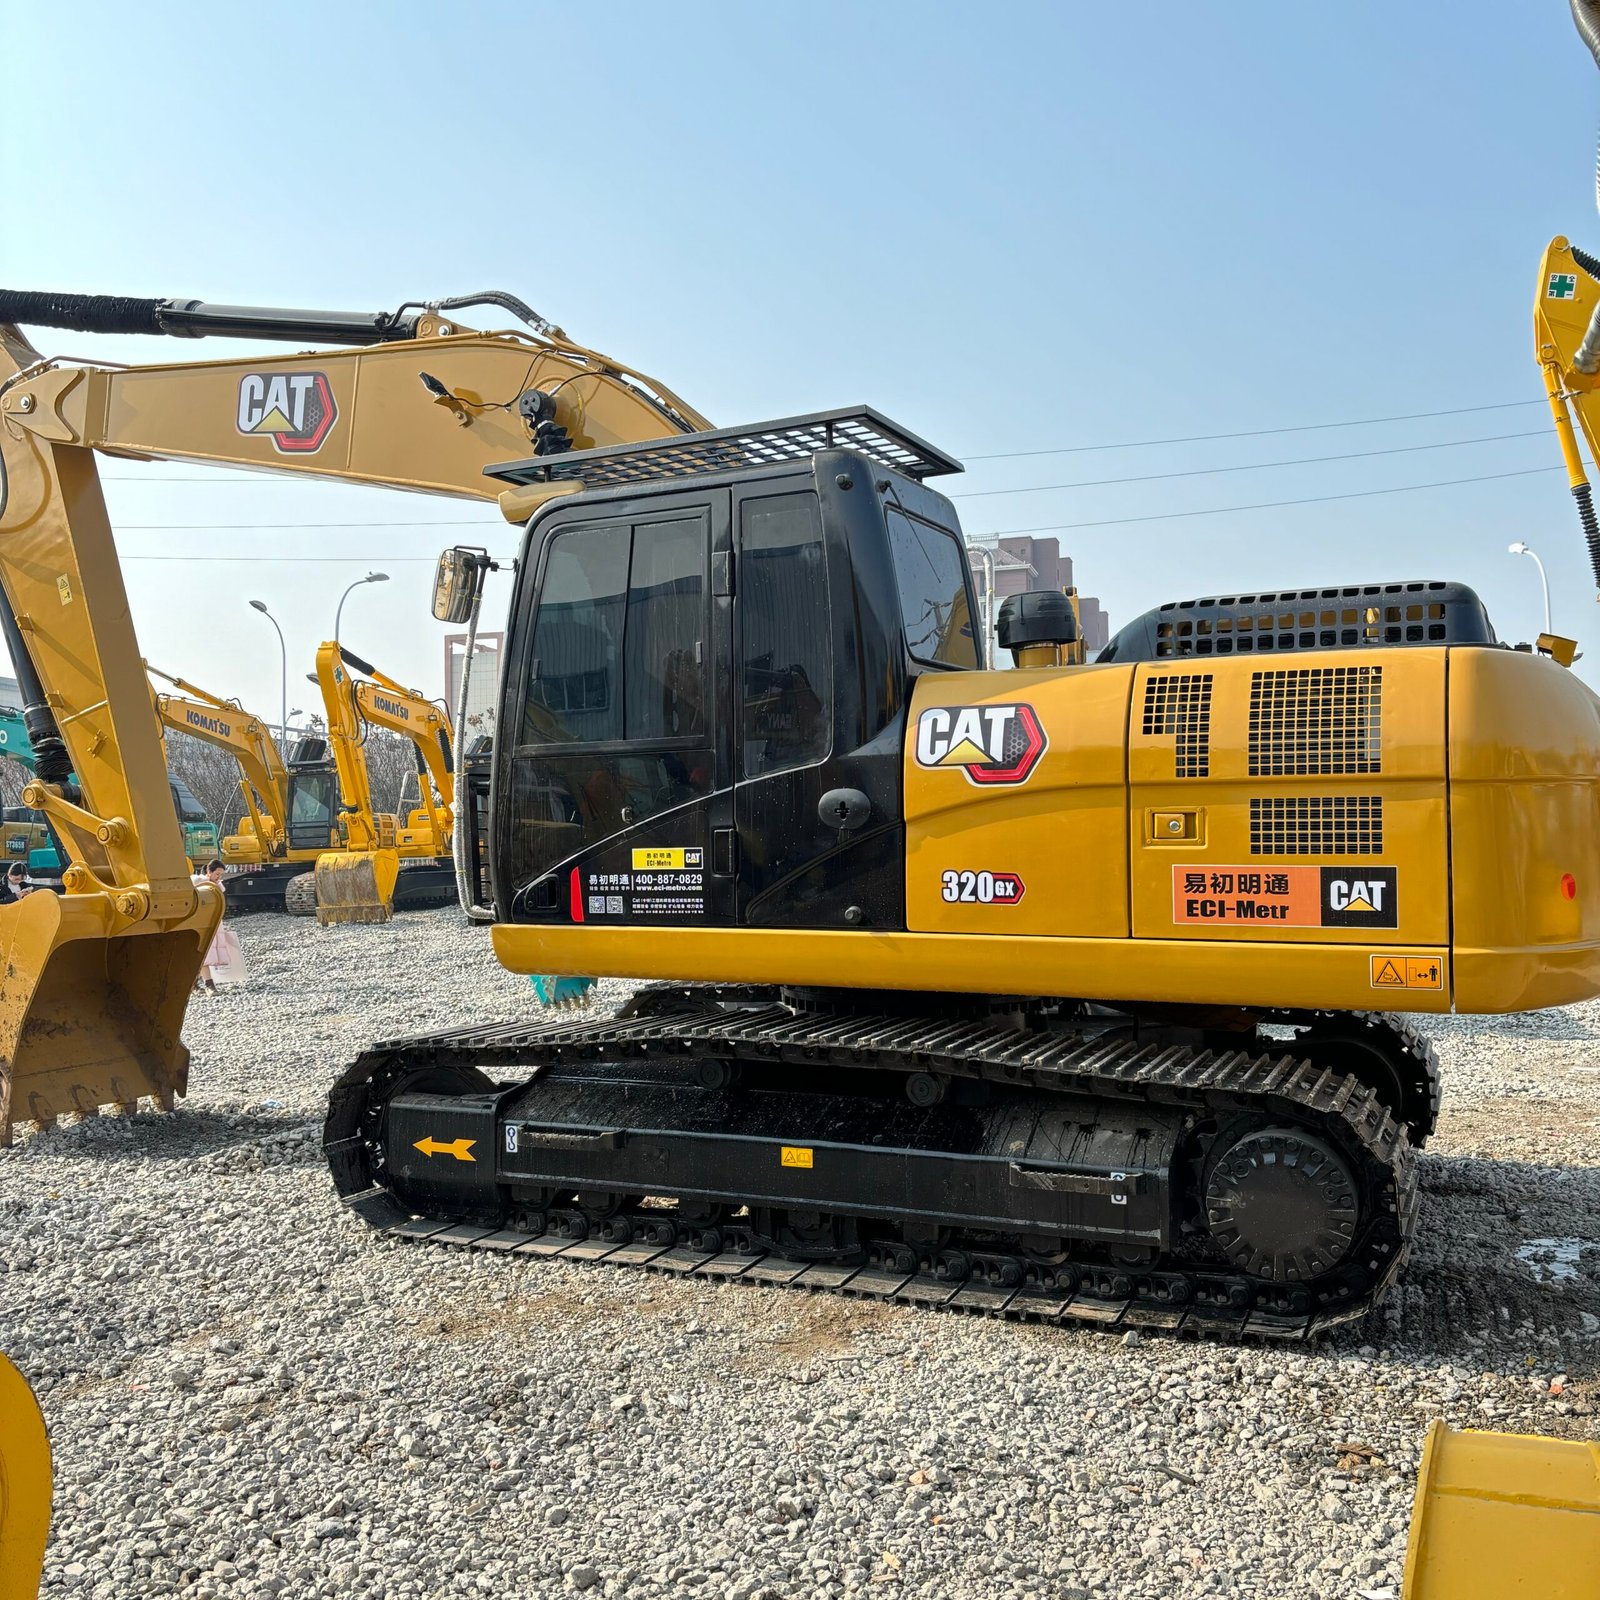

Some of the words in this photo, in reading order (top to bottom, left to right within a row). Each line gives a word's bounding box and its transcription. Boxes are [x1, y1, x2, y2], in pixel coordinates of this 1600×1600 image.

[238, 374, 314, 432] CAT
[374, 695, 409, 720] KOMATSU
[186, 709, 230, 737] KOMATSU
[917, 706, 1016, 765] CAT
[646, 859, 672, 867] ECI-Metro
[685, 853, 700, 863] CAT
[589, 874, 630, 885] 易初明通
[636, 874, 703, 884] 400-887-0829
[942, 871, 1015, 903] 320GX
[1184, 873, 1290, 895] 易初明通
[1330, 880, 1386, 912] CAT
[1186, 899, 1290, 919] ECI-Metr
